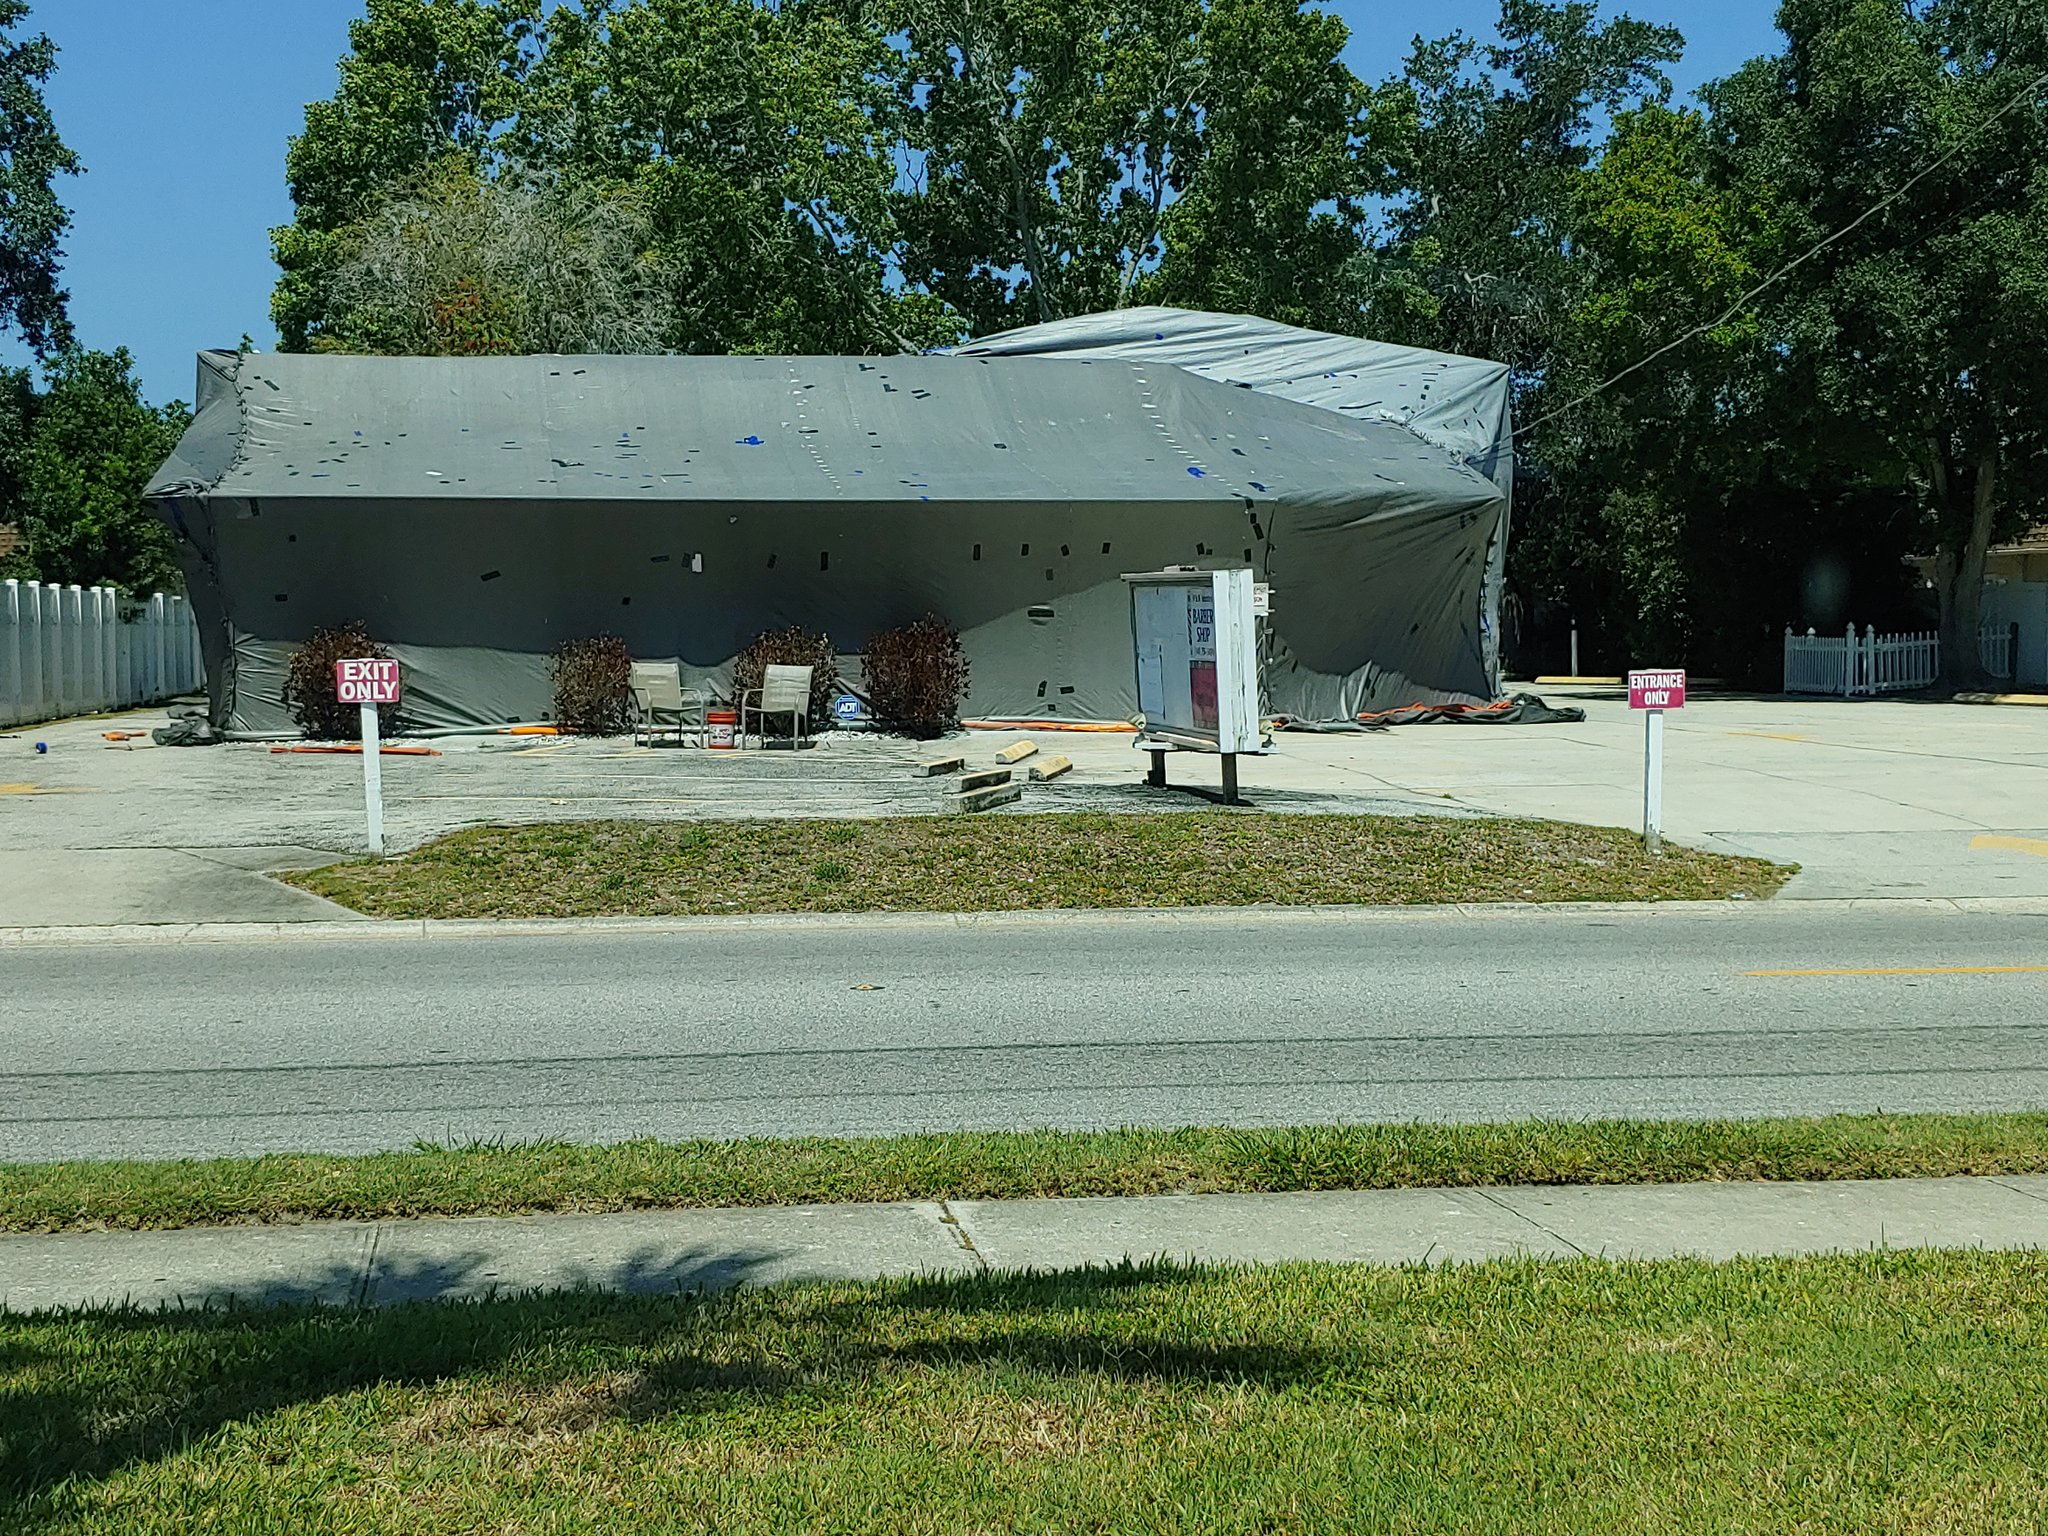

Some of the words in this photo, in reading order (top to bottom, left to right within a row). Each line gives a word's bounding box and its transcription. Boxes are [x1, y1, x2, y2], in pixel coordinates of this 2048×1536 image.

[1192, 608, 1214, 624] BARBER
[1196, 627, 1211, 642] SHOP
[344, 662, 393, 680] EXIT
[1631, 674, 1683, 689] ENTRANCE
[340, 681, 397, 699] ONLY
[1644, 690, 1670, 705] ONLY
[839, 702, 857, 712] ADT
